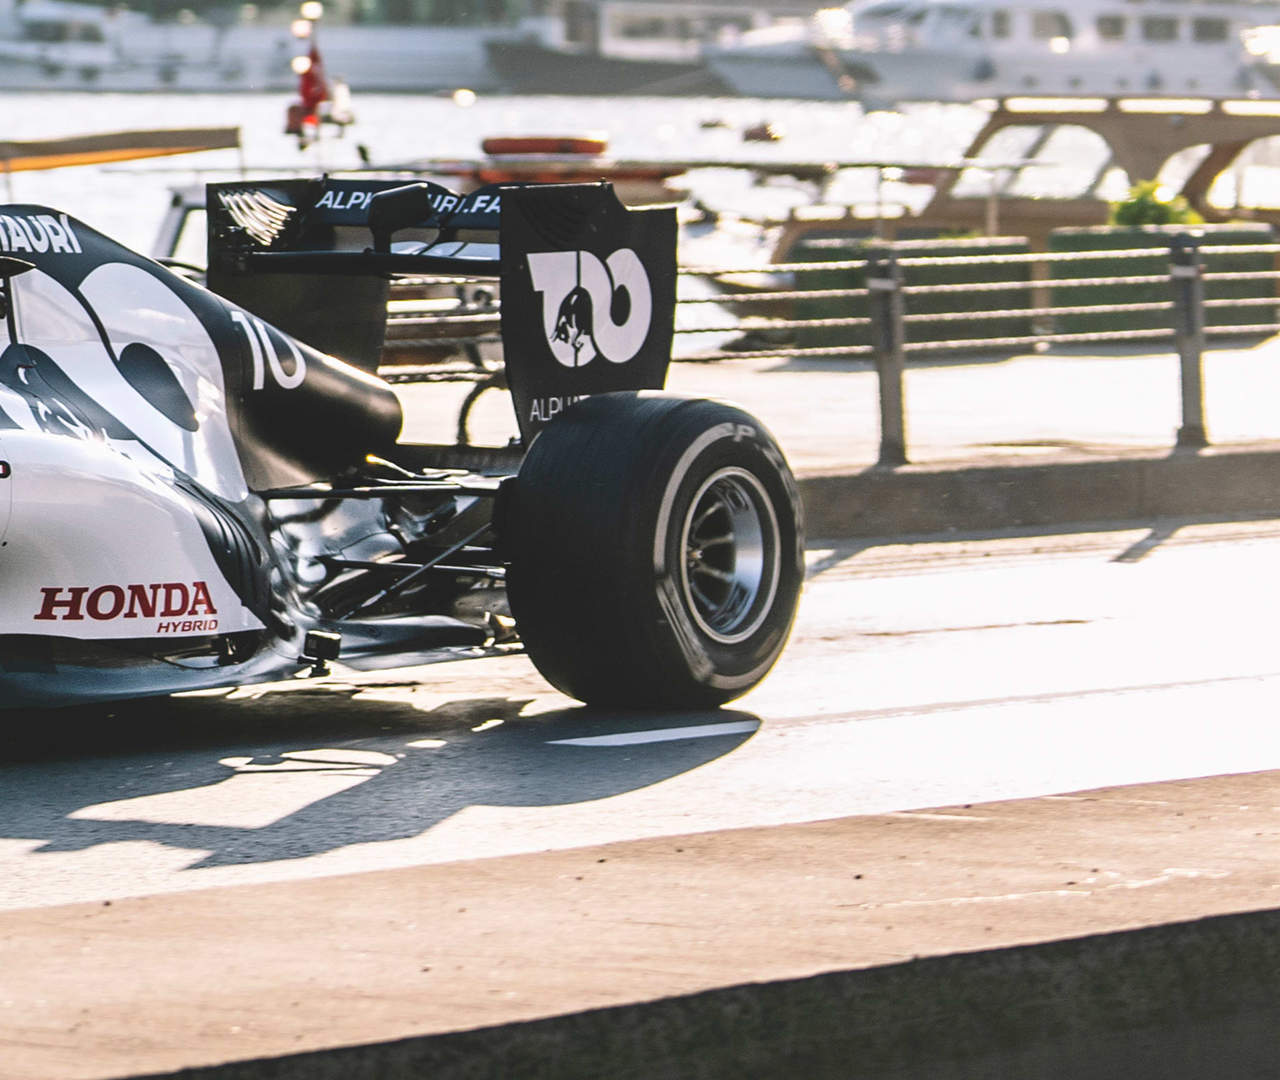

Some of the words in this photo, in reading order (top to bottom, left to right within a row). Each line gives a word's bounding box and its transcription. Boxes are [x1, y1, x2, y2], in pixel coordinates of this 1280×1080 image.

[231, 311, 306, 390] 10
[34, 581, 217, 621] HONDA
[156, 619, 218, 633] HYBRID
